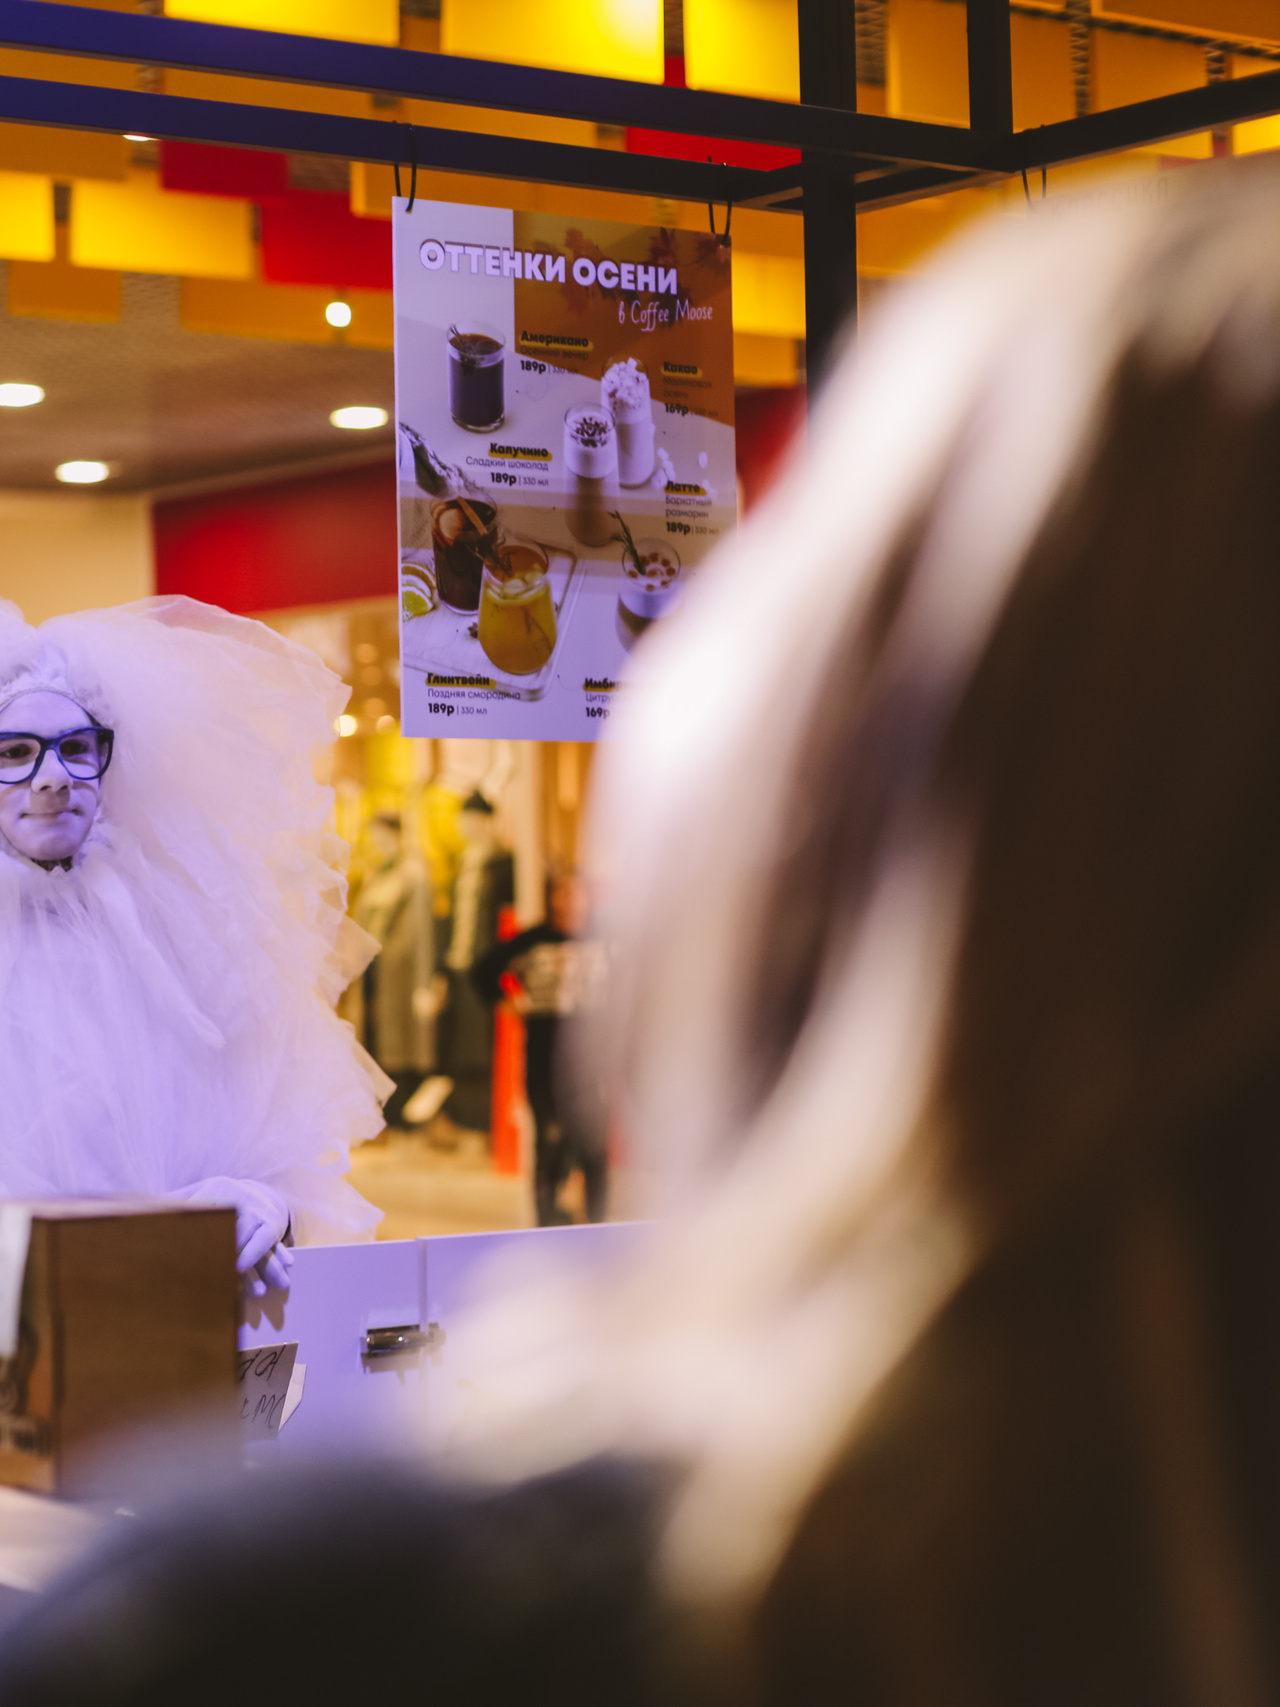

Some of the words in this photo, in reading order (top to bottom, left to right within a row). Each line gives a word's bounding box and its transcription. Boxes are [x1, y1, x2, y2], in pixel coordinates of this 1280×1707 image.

[420, 240, 566, 284] ОТТЕНКИ
[572, 257, 678, 295] ОСЕНИ
[631, 300, 669, 332] Coffee
[676, 299, 713, 321] Moose
[521, 330, 589, 347] Американо
[520, 360, 547, 374] 189р
[663, 361, 698, 374] Какао
[490, 443, 549, 457] Капучино
[465, 456, 506, 467] Сладкий
[508, 460, 549, 471] шоколад
[490, 472, 517, 486] 189р
[666, 481, 700, 493] Латте
[666, 522, 691, 536] 189р
[427, 673, 490, 685] Глинтвейн
[428, 688, 465, 699] Поздняя
[468, 691, 521, 700] смородина
[428, 703, 455, 717] 189р
